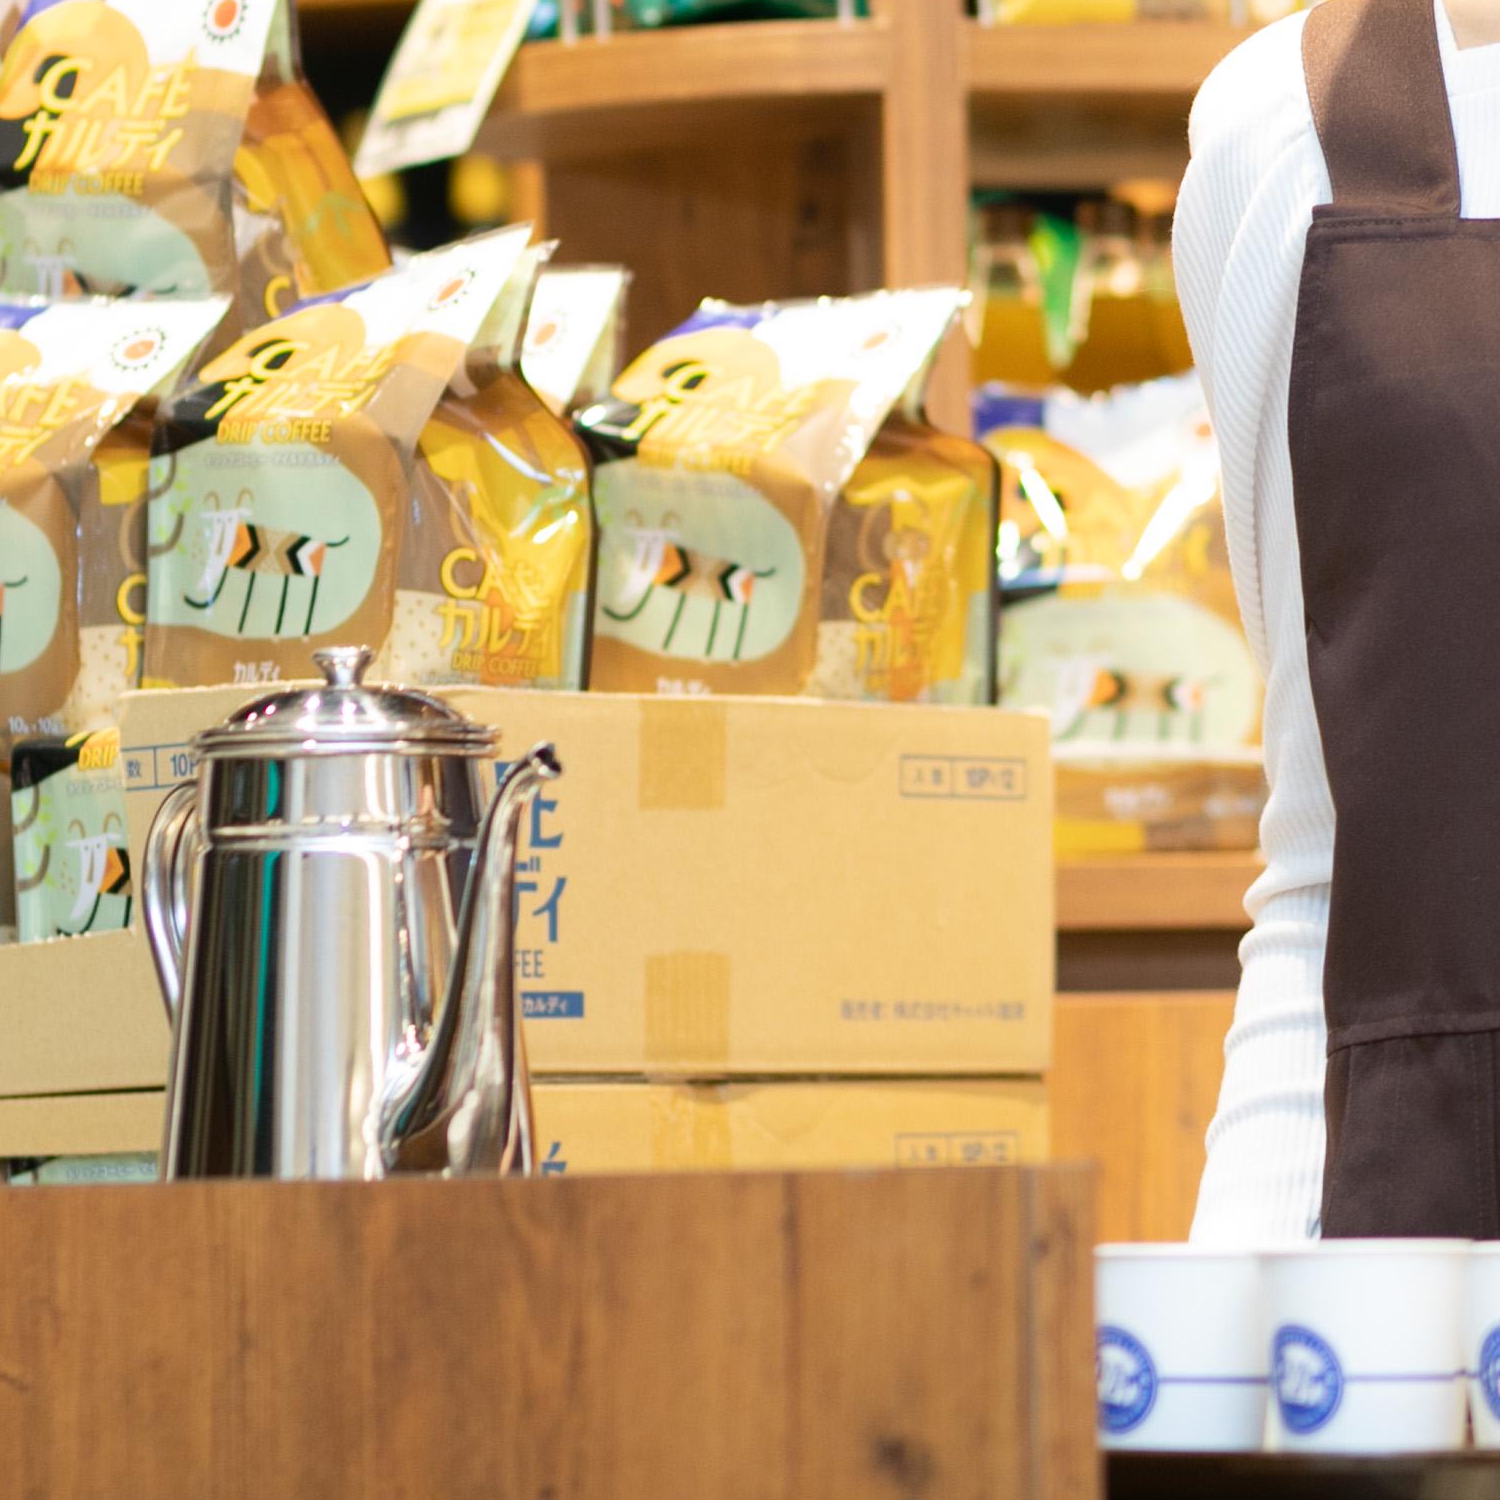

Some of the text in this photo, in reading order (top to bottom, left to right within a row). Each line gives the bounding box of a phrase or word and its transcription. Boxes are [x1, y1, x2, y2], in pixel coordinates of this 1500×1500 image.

[12, 111, 184, 173] カルディ
[204, 376, 378, 424] カルディ
[215, 417, 333, 444] DRIP COFFEE
[233, 660, 281, 684] カルディ
